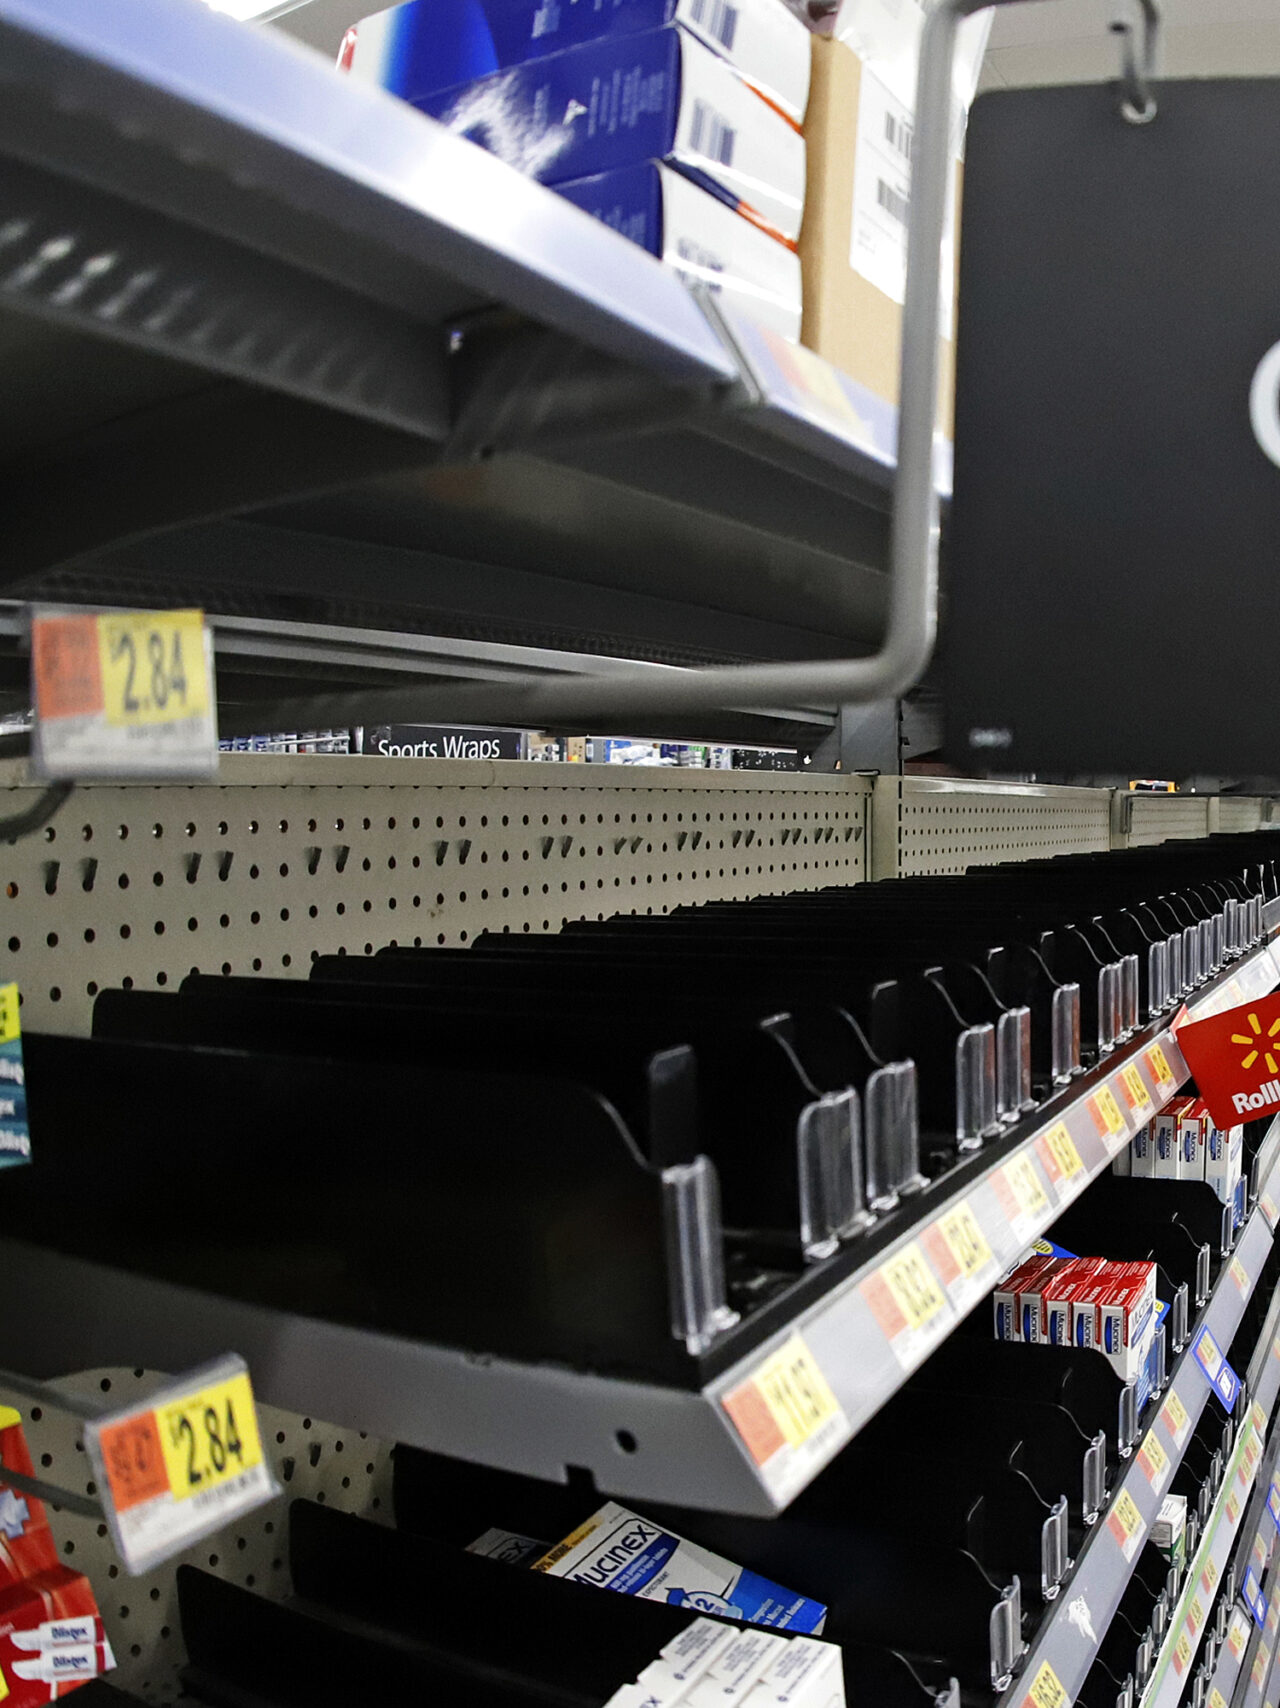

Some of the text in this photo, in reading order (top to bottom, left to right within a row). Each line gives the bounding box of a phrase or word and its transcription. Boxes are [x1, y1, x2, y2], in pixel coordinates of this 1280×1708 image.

[378, 735, 500, 759] Sports Wraps
[1030, 1306, 1039, 1342] Mucinex
[1085, 1316, 1093, 1348] Mucine
[1112, 1318, 1121, 1353] Mucinex
[178, 1396, 243, 1484] 2.84
